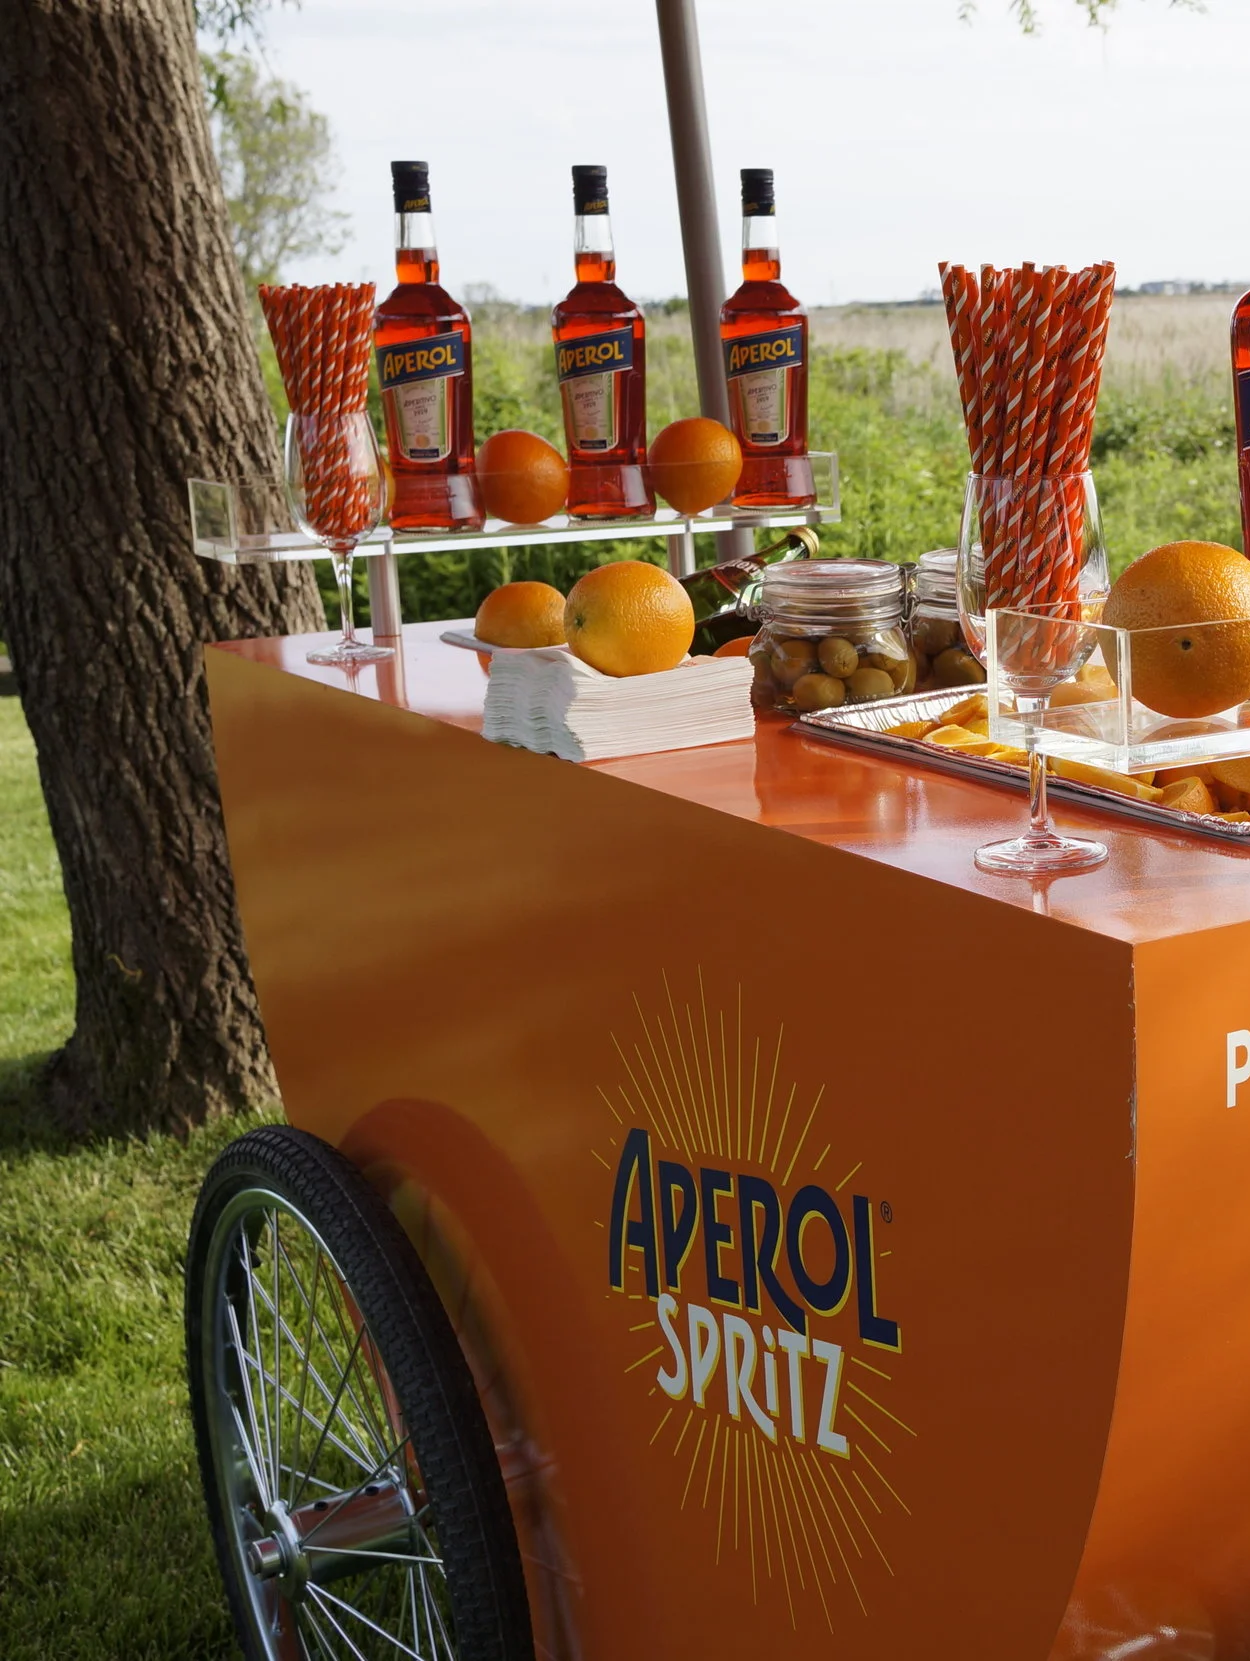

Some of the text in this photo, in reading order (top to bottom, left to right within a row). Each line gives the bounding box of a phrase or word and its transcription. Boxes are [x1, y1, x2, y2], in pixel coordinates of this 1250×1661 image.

[383, 344, 457, 381] APEROL
[559, 341, 624, 373] APEROL
[730, 337, 796, 371] APEROL
[609, 1127, 902, 1354] APEROL
